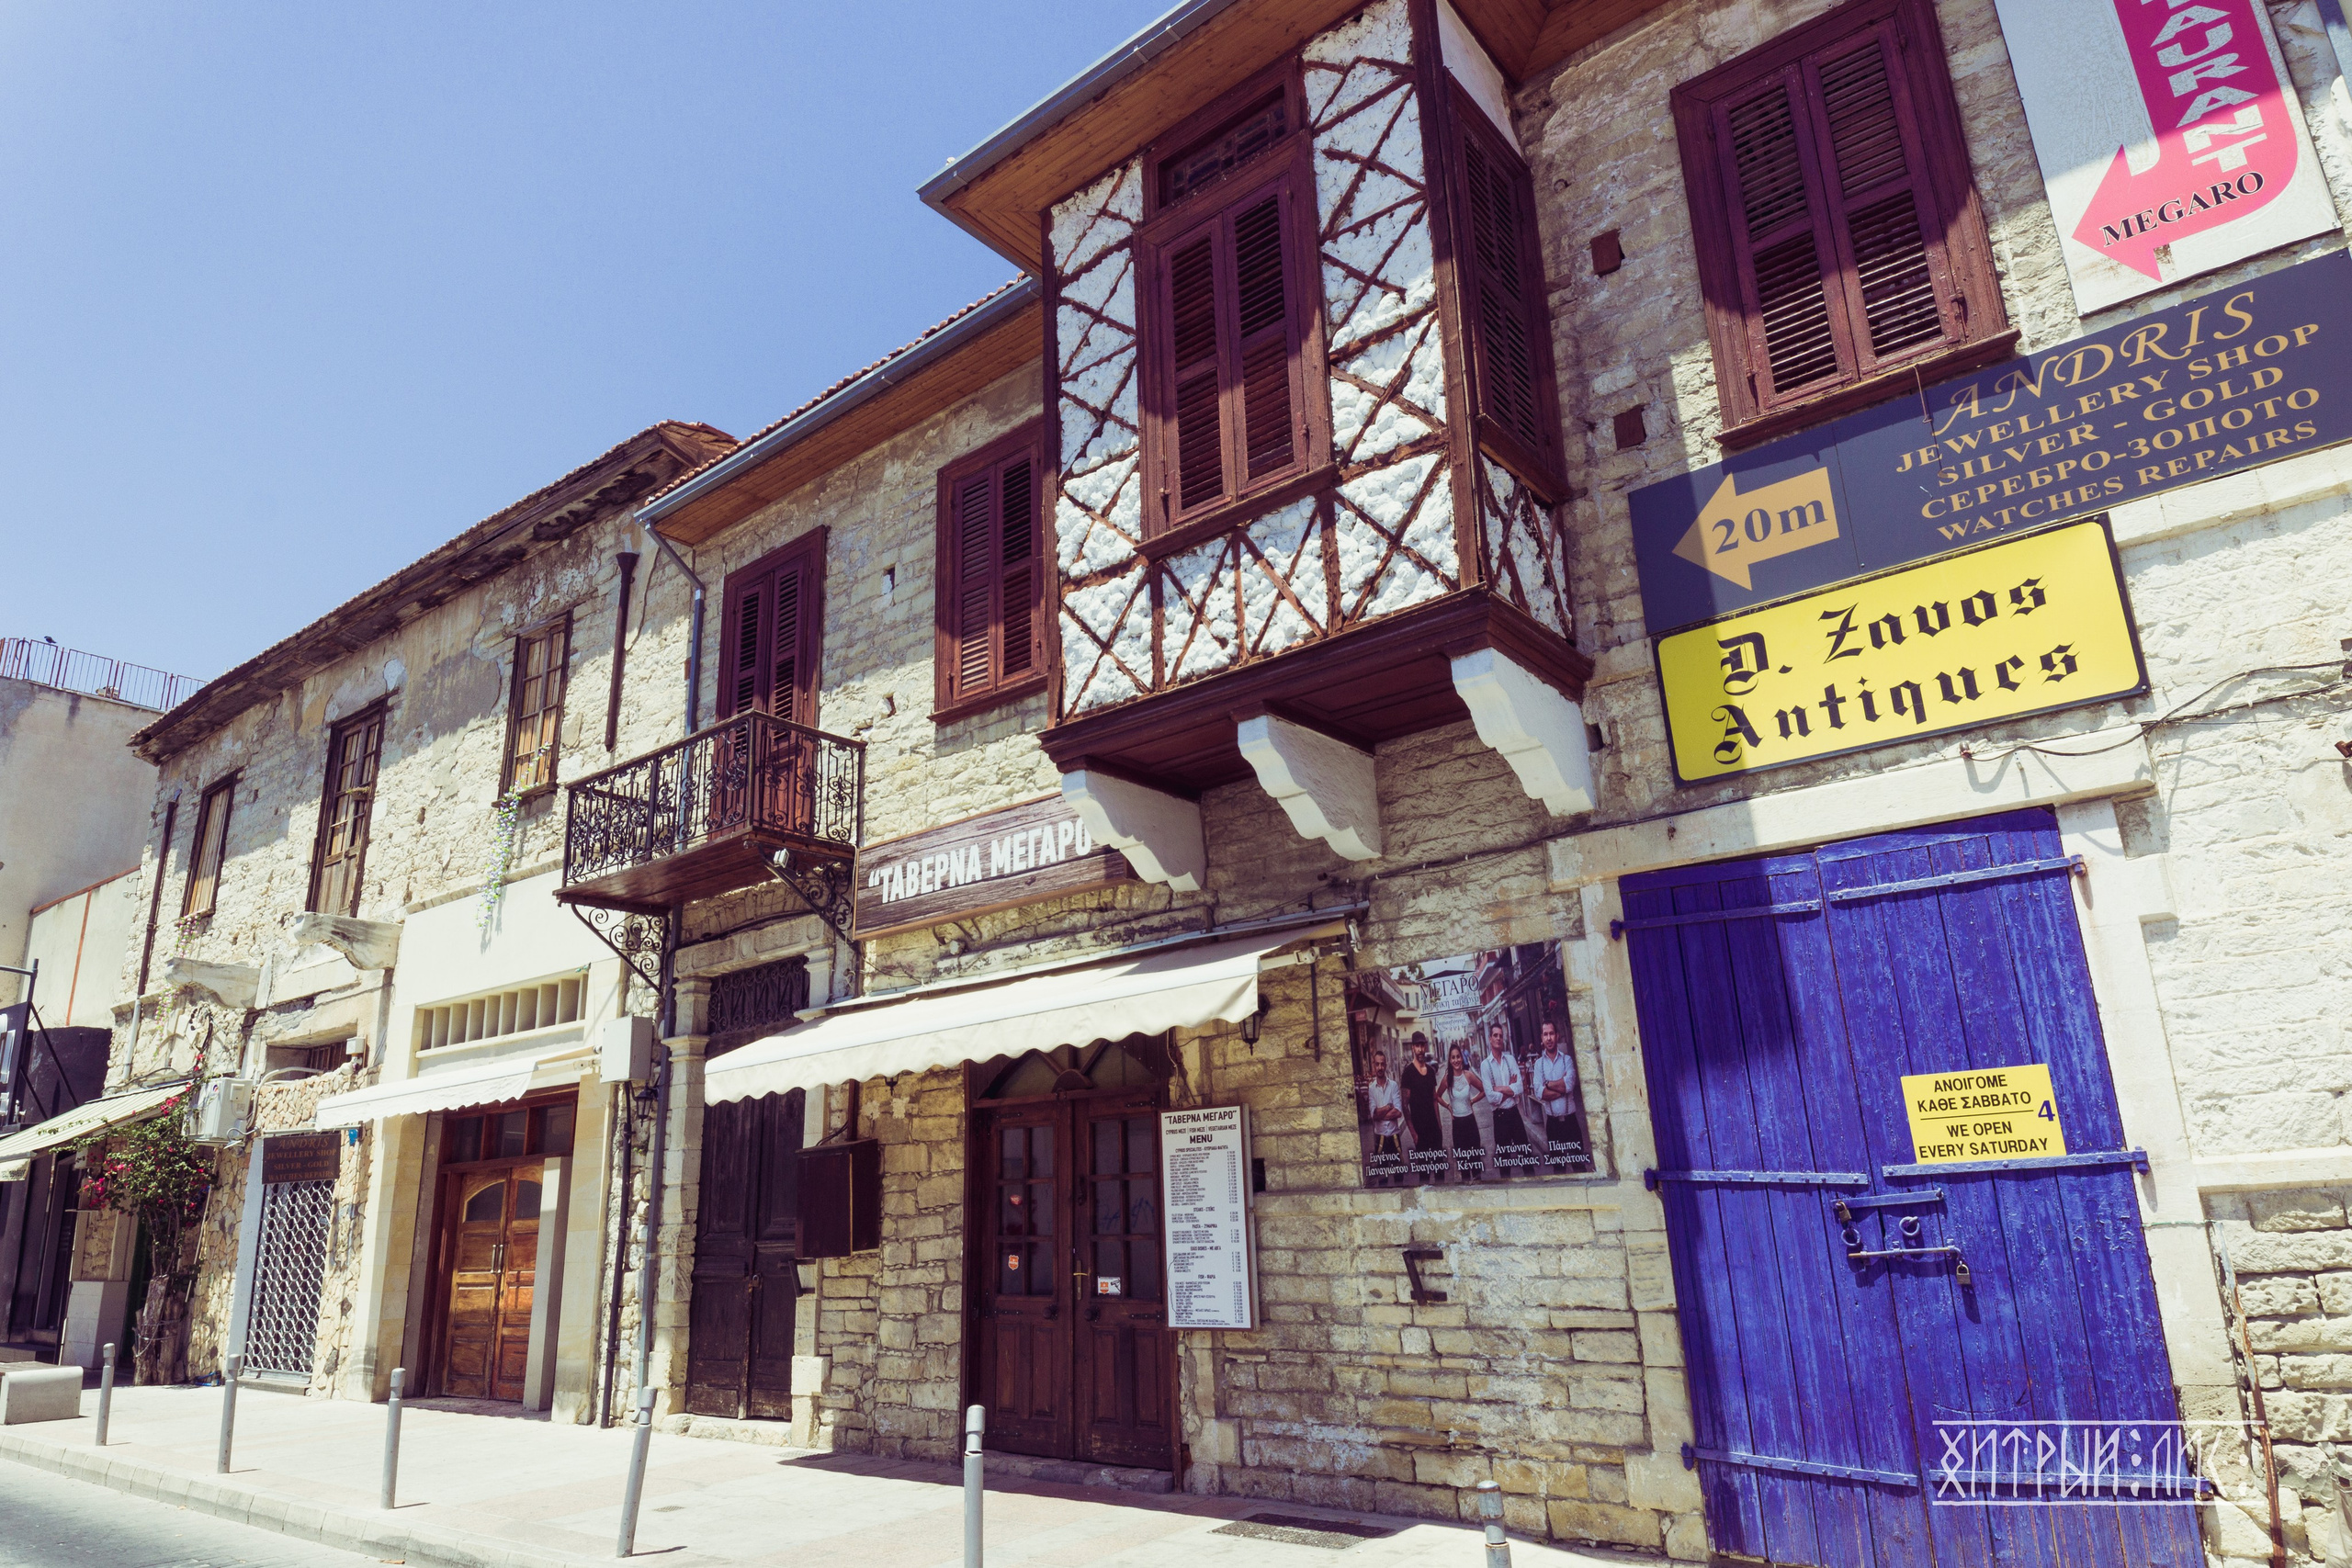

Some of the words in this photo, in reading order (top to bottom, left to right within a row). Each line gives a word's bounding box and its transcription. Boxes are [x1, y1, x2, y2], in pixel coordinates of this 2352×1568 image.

[2141, 0, 2267, 173] AURANT
[2100, 170, 2265, 248] MEGARO
[1932, 291, 2255, 436] ANDRIS
[1895, 369, 2170, 473] JEWELLERY
[2188, 323, 2319, 380] SHOP
[1938, 423, 2100, 487] SILVER
[2143, 367, 2284, 421] GOLD
[1937, 476, 2124, 541] WATCHES
[2135, 420, 2317, 487] REPAIRS
[1712, 498, 1828, 555] 20m
[1717, 631, 1793, 696] D.
[1817, 575, 2048, 663] Zavos
[1711, 641, 2080, 765] Antiques
[1934, 1074, 2007, 1093] ΑΝΟΙΓΟΜΕ
[1917, 1096, 1958, 1112] ΚΑΘΕ
[1962, 1091, 2031, 1110] ΣΑΒΒΑΤΟ
[2038, 1100, 2055, 1122] 4
[1190, 1134, 1213, 1144] MENU
[1946, 1124, 1969, 1138] WE
[1973, 1121, 2013, 1136] OPEN
[266, 1150, 314, 1159] JEWELLERY
[316, 1148, 337, 1156] SHOP
[1408, 1148, 1448, 1161] Ευαγόρας
[1453, 1146, 1486, 1159] Μαρίνα
[1495, 1142, 1532, 1155] Αντώνης
[1548, 1140, 1581, 1153] Πάμπος
[1918, 1144, 1964, 1158] EVERY
[1970, 1137, 2048, 1156] SATURDAY
[274, 1162, 301, 1170] SILVER
[1410, 1160, 1449, 1174] Ευαγόρου
[1457, 1159, 1485, 1171] Κέντη
[1544, 1153, 1591, 1167] Σωκράτους
[268, 1173, 303, 1181] WATCHES
